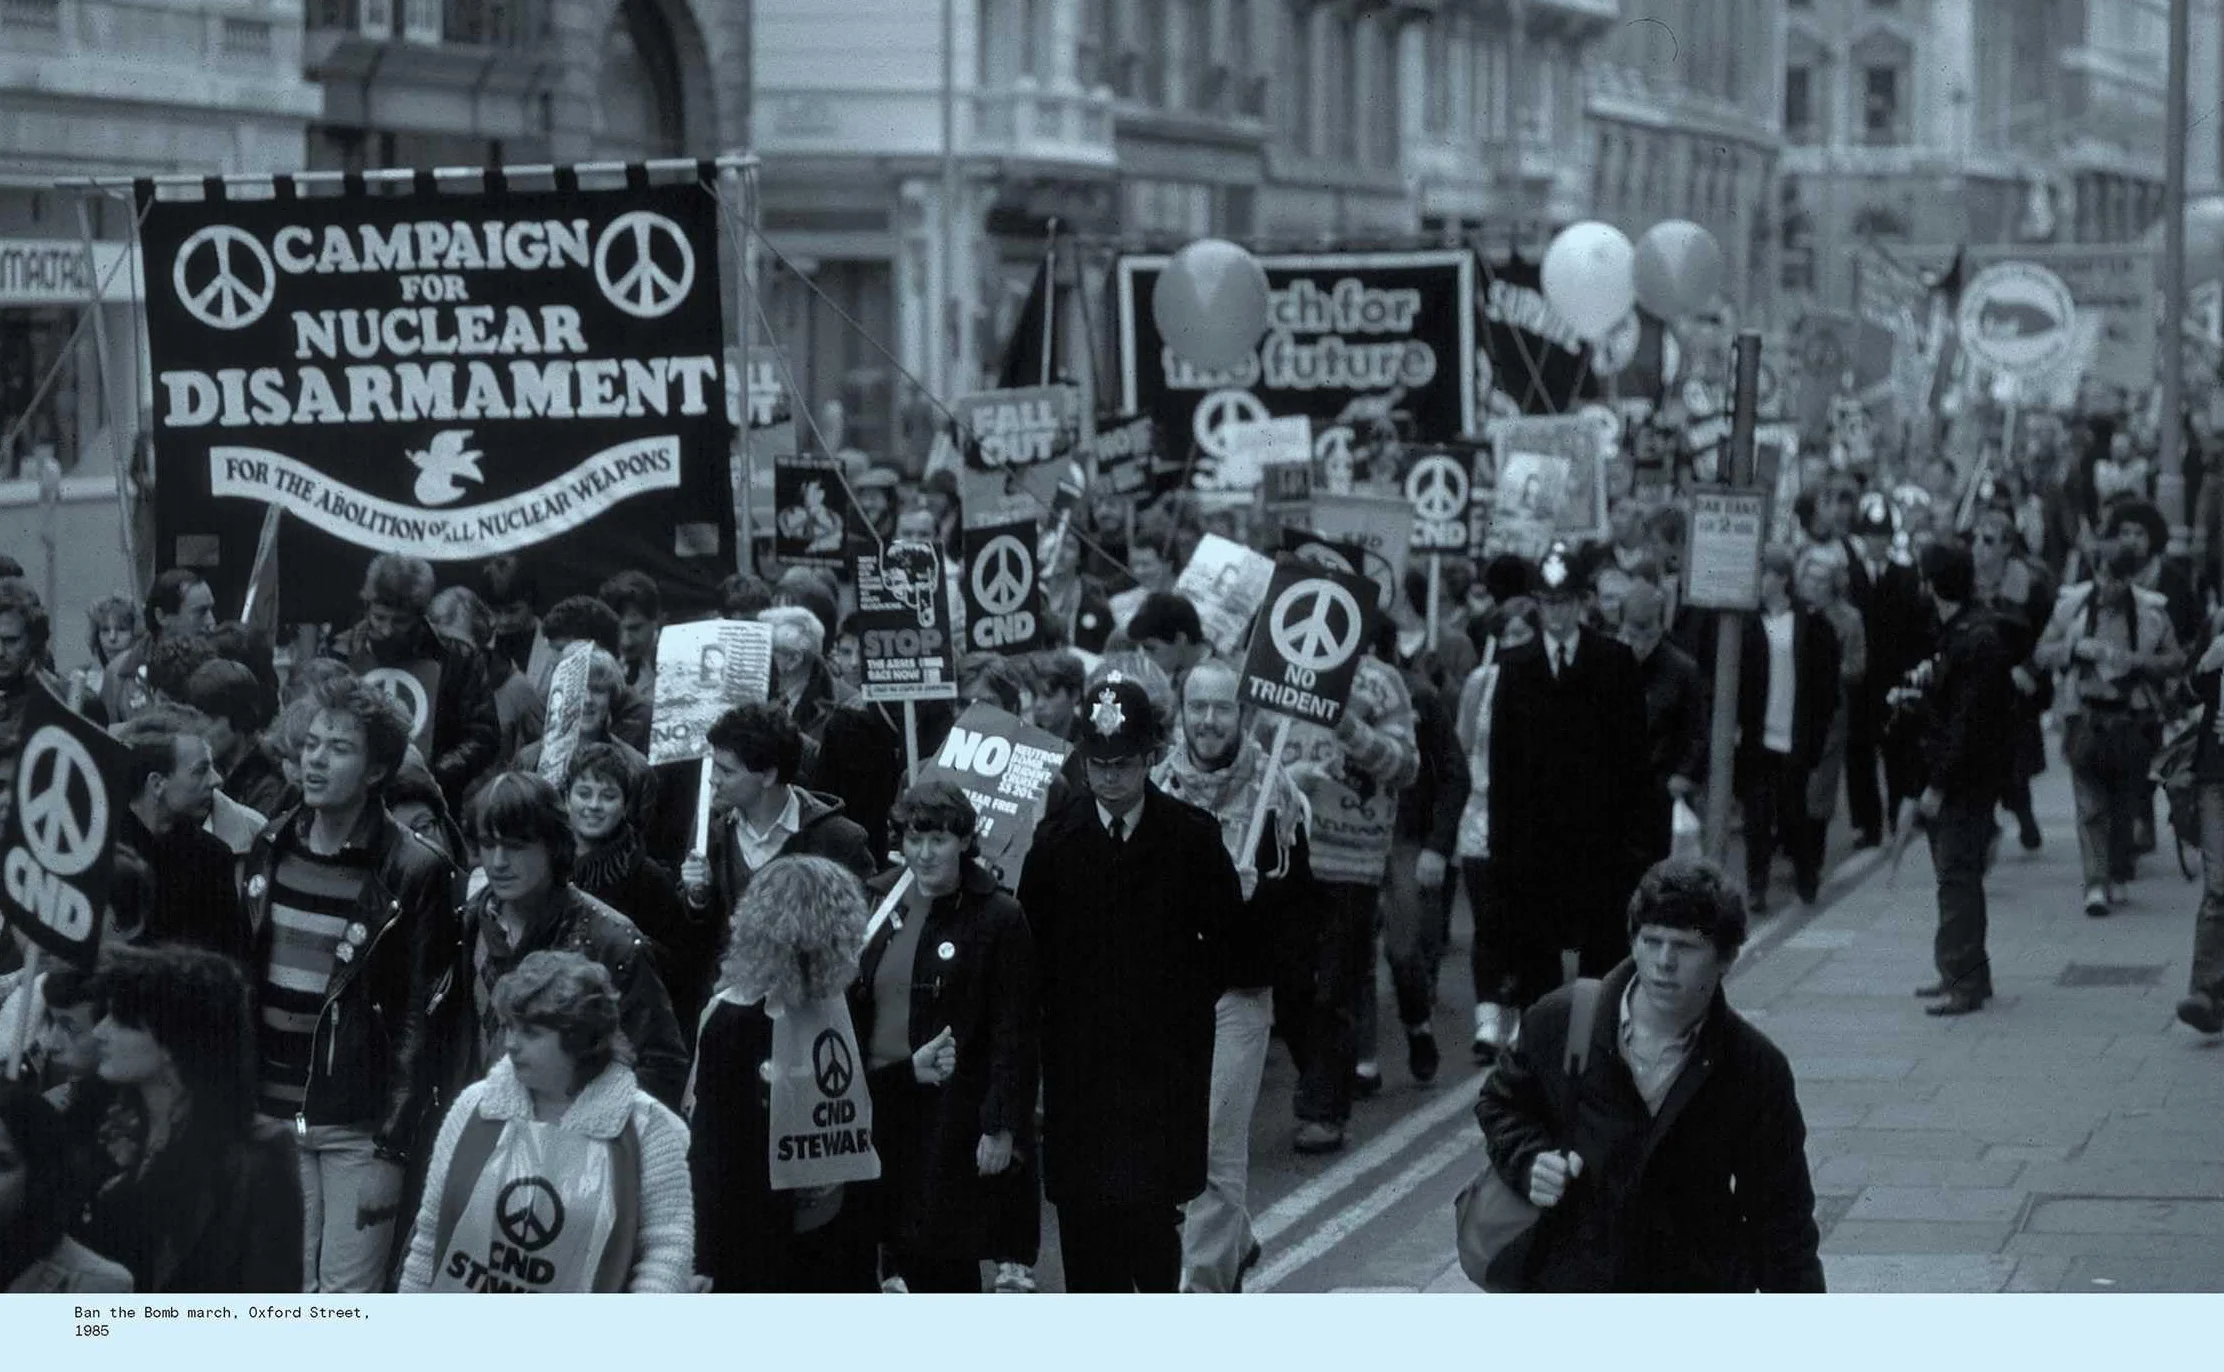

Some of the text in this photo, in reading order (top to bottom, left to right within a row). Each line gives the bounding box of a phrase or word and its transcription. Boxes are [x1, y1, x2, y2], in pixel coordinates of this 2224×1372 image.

[272, 219, 590, 273] CAMPAIGN
[400, 275, 468, 301] FOR
[1332, 278, 1420, 333] for
[294, 306, 587, 358] NUCLEAR
[1261, 328, 1437, 389] future
[161, 357, 715, 427] DISARMAMENT
[972, 401, 1058, 437] FALL
[981, 432, 1057, 467] OUT
[225, 457, 268, 485] FOR
[275, 467, 315, 501] THE
[313, 488, 426, 542] ABOLITION
[443, 521, 475, 543] ALL
[477, 490, 571, 541] NUCLEAR
[571, 448, 670, 500] WEAPONS
[864, 628, 943, 657] STOP
[973, 610, 1036, 648] CND
[1249, 676, 1340, 721] TRIDENT
[1284, 664, 1316, 689] NO
[938, 726, 1011, 777] NO
[1013, 742, 1064, 765] NEUTRON
[4, 846, 94, 942] CND
[813, 1100, 856, 1127] CND
[777, 1127, 872, 1161] STEWAR
[489, 1240, 556, 1286] CND
